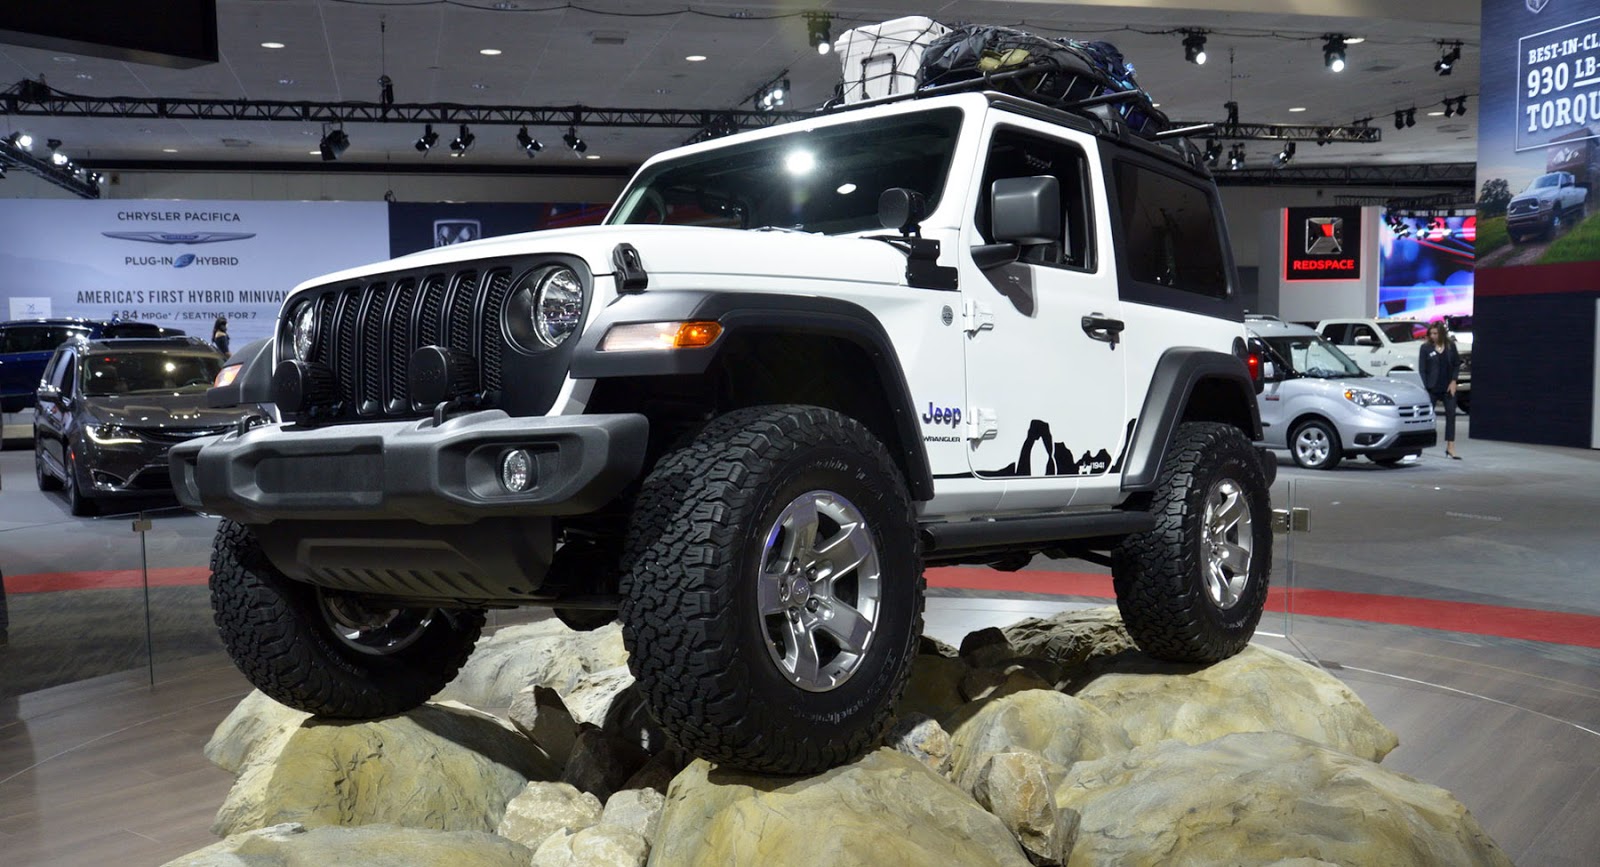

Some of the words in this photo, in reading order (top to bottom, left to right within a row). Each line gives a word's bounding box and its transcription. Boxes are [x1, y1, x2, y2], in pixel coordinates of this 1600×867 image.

[1528, 32, 1600, 65] BEST-IN-CL
[1527, 62, 1569, 98] 930
[1526, 91, 1600, 132] TORQU
[117, 211, 181, 221] CHRYSLER
[184, 212, 241, 222] PACIFICA
[125, 256, 173, 266] PLUG-IN
[195, 256, 239, 266] HYBRID
[1293, 259, 1355, 270] REDSPACE
[77, 290, 145, 304] AMERICA'S
[148, 290, 184, 303] FIRST
[188, 290, 234, 303] HYBRID
[121, 310, 138, 320] 84
[182, 312, 225, 320] SEATING
[227, 312, 249, 320] FOR
[922, 401, 961, 429] Jeep
